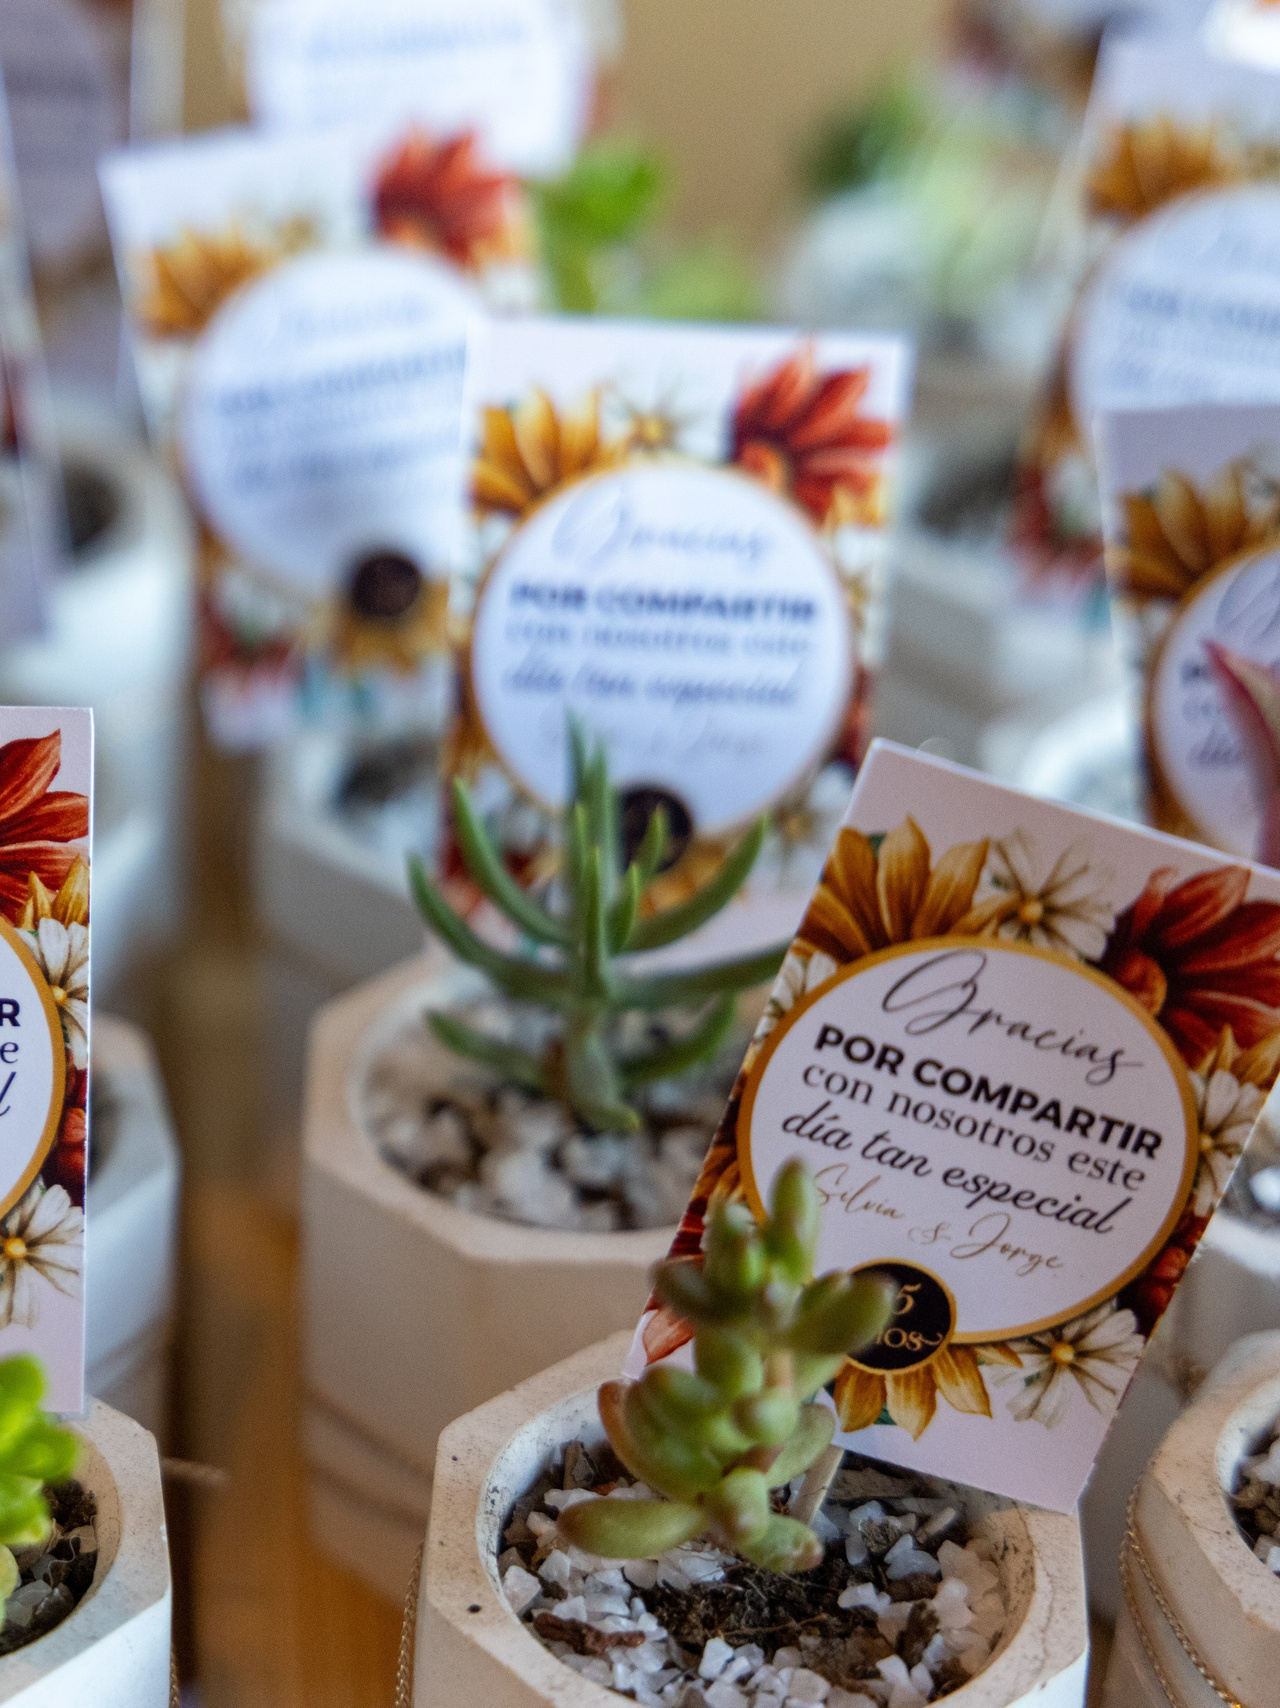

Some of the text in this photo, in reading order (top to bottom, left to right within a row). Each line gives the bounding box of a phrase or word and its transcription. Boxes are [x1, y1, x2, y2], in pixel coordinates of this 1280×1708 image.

[882, 947, 1143, 1086] Gracias
[802, 1063, 1145, 1192] con nosotros este
[814, 1023, 1163, 1160] POR COMPARTIR
[782, 1100, 1132, 1235] día tan especial
[950, 1212, 1064, 1277] Jorge
